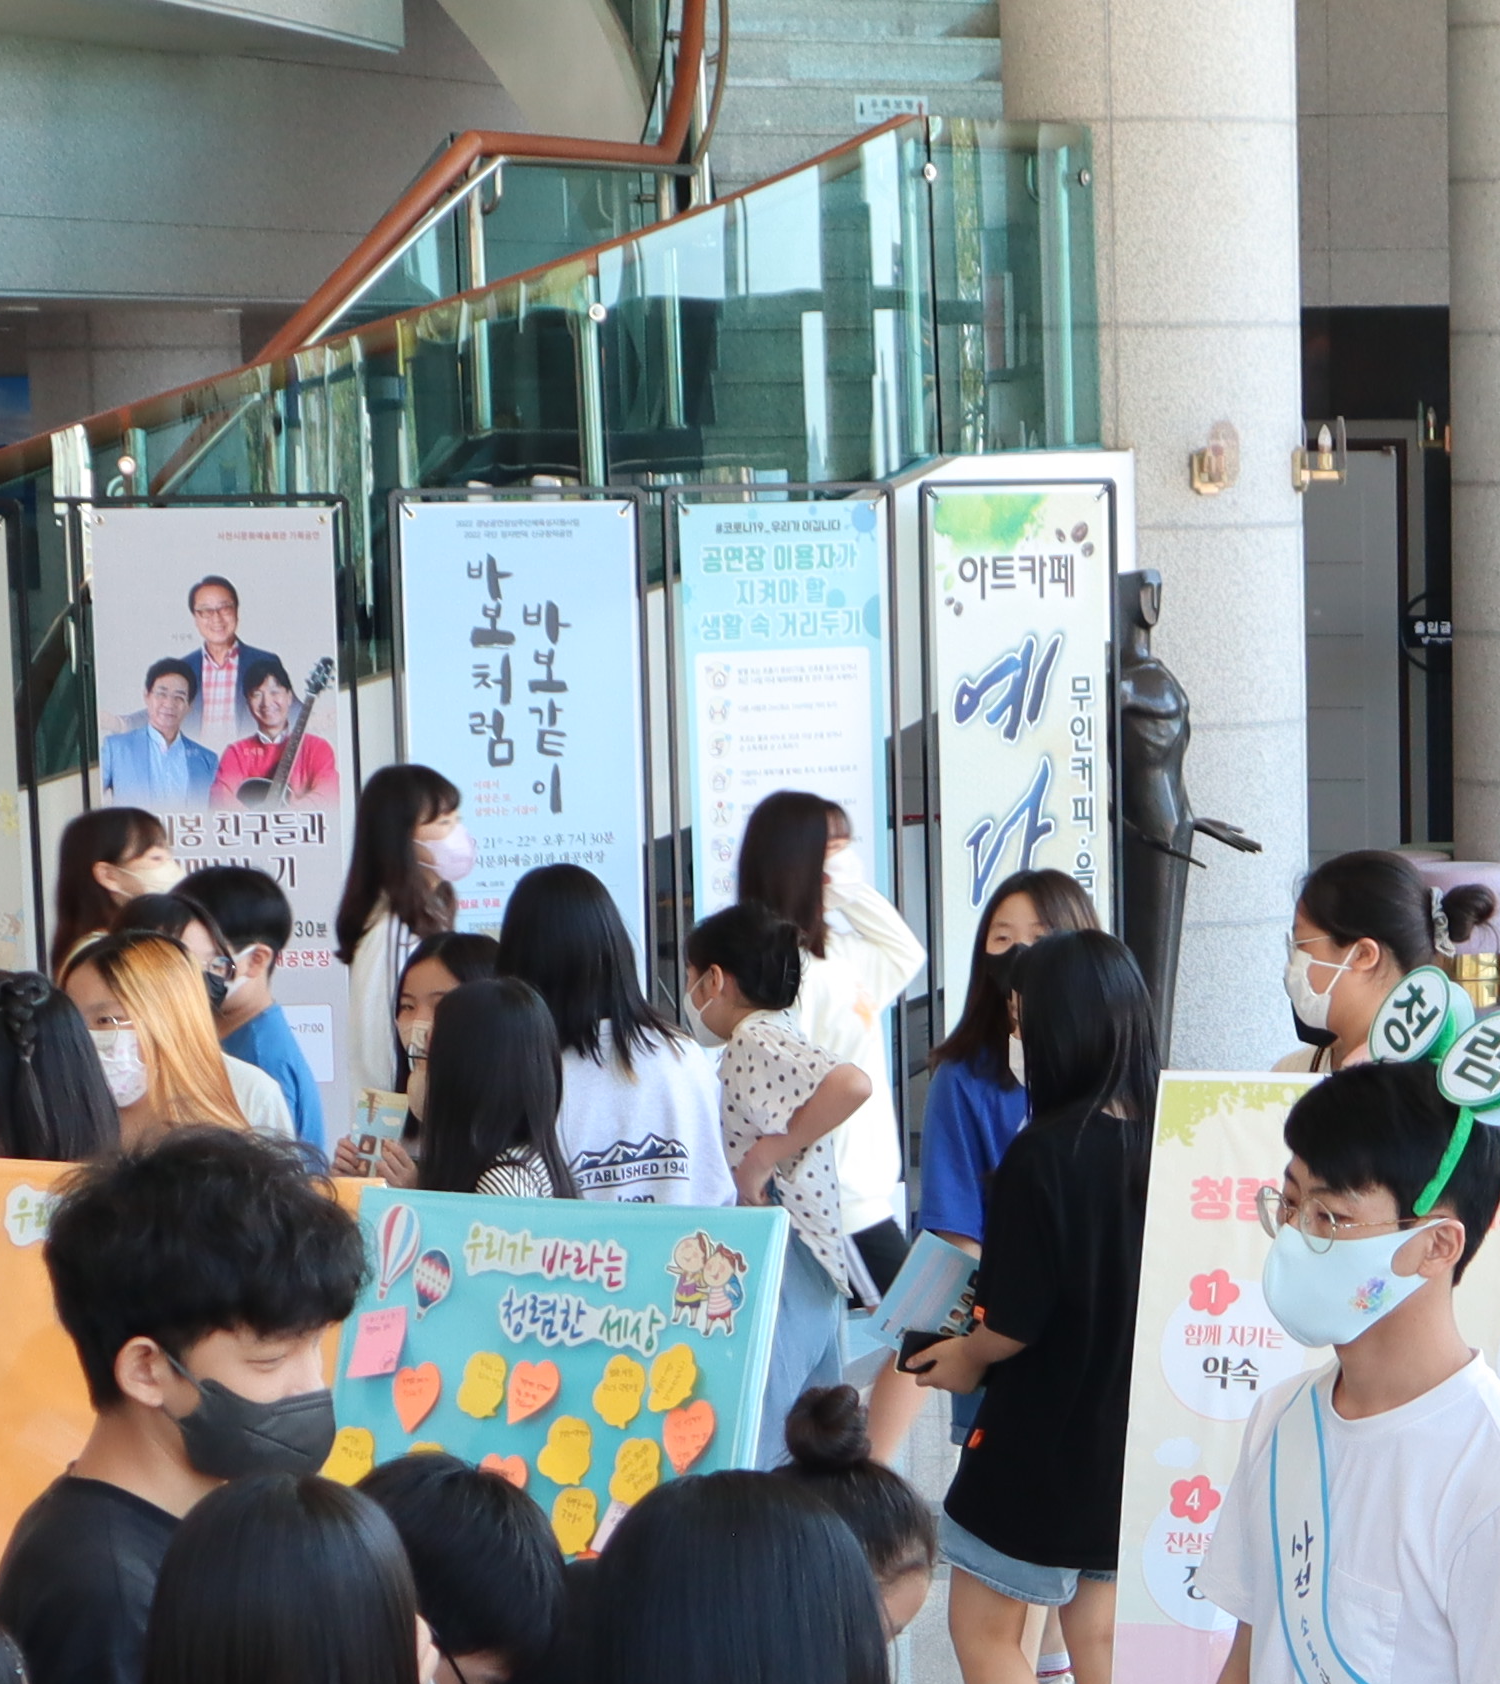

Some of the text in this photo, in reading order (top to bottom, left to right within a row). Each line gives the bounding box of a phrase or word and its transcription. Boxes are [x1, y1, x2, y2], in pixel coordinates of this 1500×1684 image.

[702, 543, 857, 573] 공연장 이용자가
[736, 576, 826, 605] 지켜야 할
[958, 554, 1075, 600] 아트카페
[701, 610, 861, 641] 생활 속 거리두기
[466, 552, 516, 768] 바보처럼
[521, 600, 572, 815] 바보같이
[214, 811, 327, 847] 친구들과
[293, 919, 329, 938] 30분
[1382, 978, 1443, 1057] 청
[574, 1161, 660, 1187] STABLISHED
[465, 1225, 623, 1289] 우리가 바라는
[1206, 1280, 1218, 1304] 1
[501, 1285, 663, 1352] 청렴한 세상
[1183, 1322, 1285, 1350] 함께 지키는
[1202, 1356, 1261, 1392] 약속
[1184, 1487, 1201, 1511] 4
[1291, 1520, 1315, 1600] 사천
